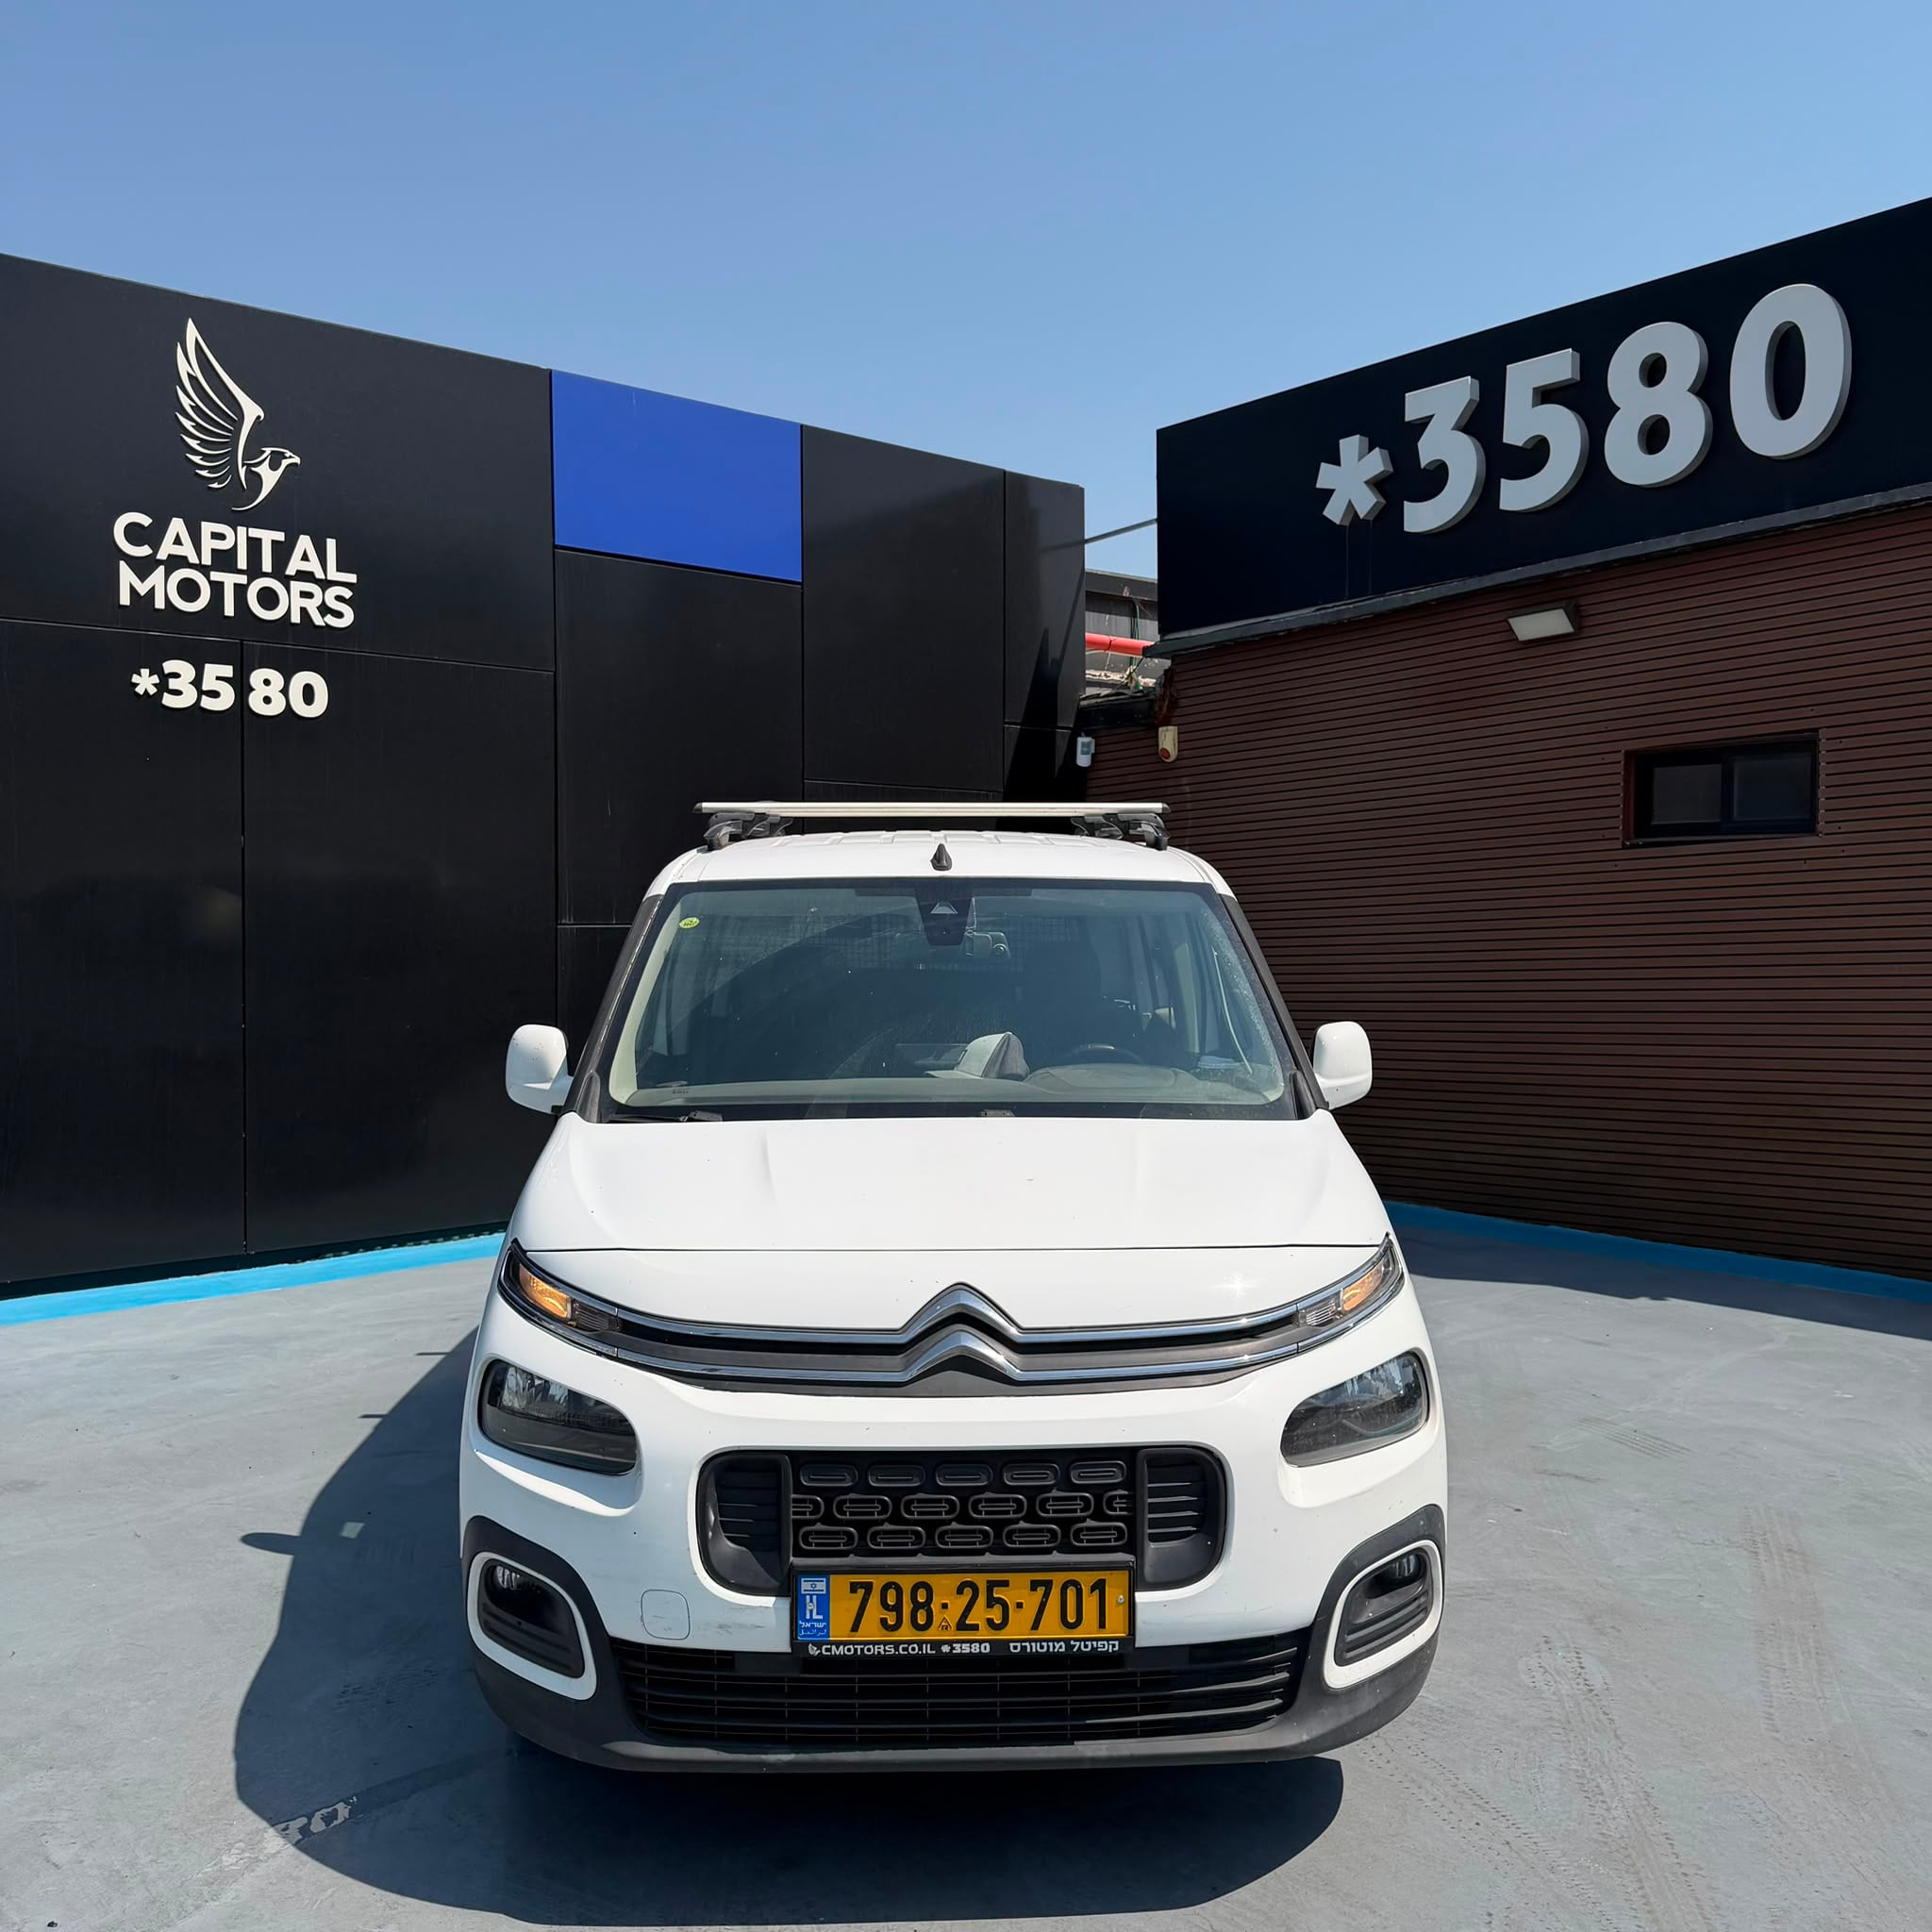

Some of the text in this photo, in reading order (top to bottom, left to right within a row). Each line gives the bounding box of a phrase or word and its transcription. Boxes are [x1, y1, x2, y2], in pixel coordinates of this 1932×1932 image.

[112, 511, 358, 584] CAPITAL
[118, 559, 355, 629] MOTORS
[799, 1620, 827, 1628] ישראל
[822, 1643, 936, 1656] CMOTORS.CO.IL
[1008, 1640, 1120, 1653] קפיטל מוטורס
